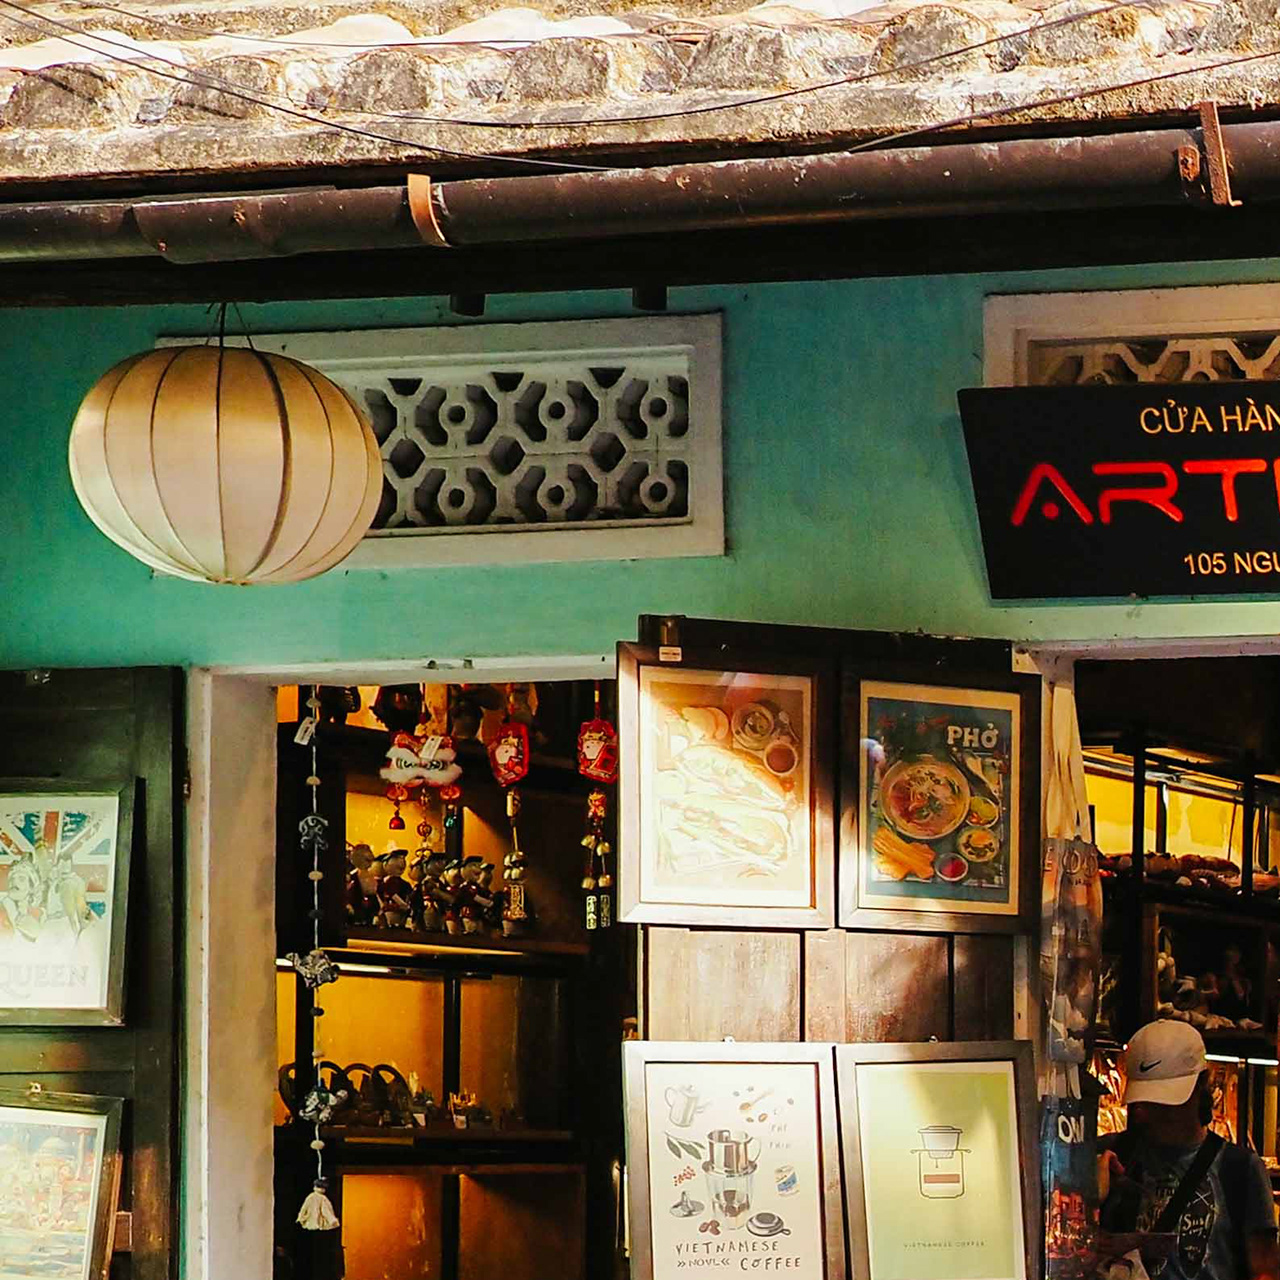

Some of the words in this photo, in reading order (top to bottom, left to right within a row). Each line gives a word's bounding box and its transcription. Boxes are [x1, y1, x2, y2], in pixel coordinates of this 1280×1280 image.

[1139, 397, 1213, 434] CỬA
[1184, 552, 1227, 575] 105
[947, 722, 999, 749] PHỞ
[675, 1241, 779, 1255] VIETNAMESE
[740, 1257, 801, 1271] COFFEE
